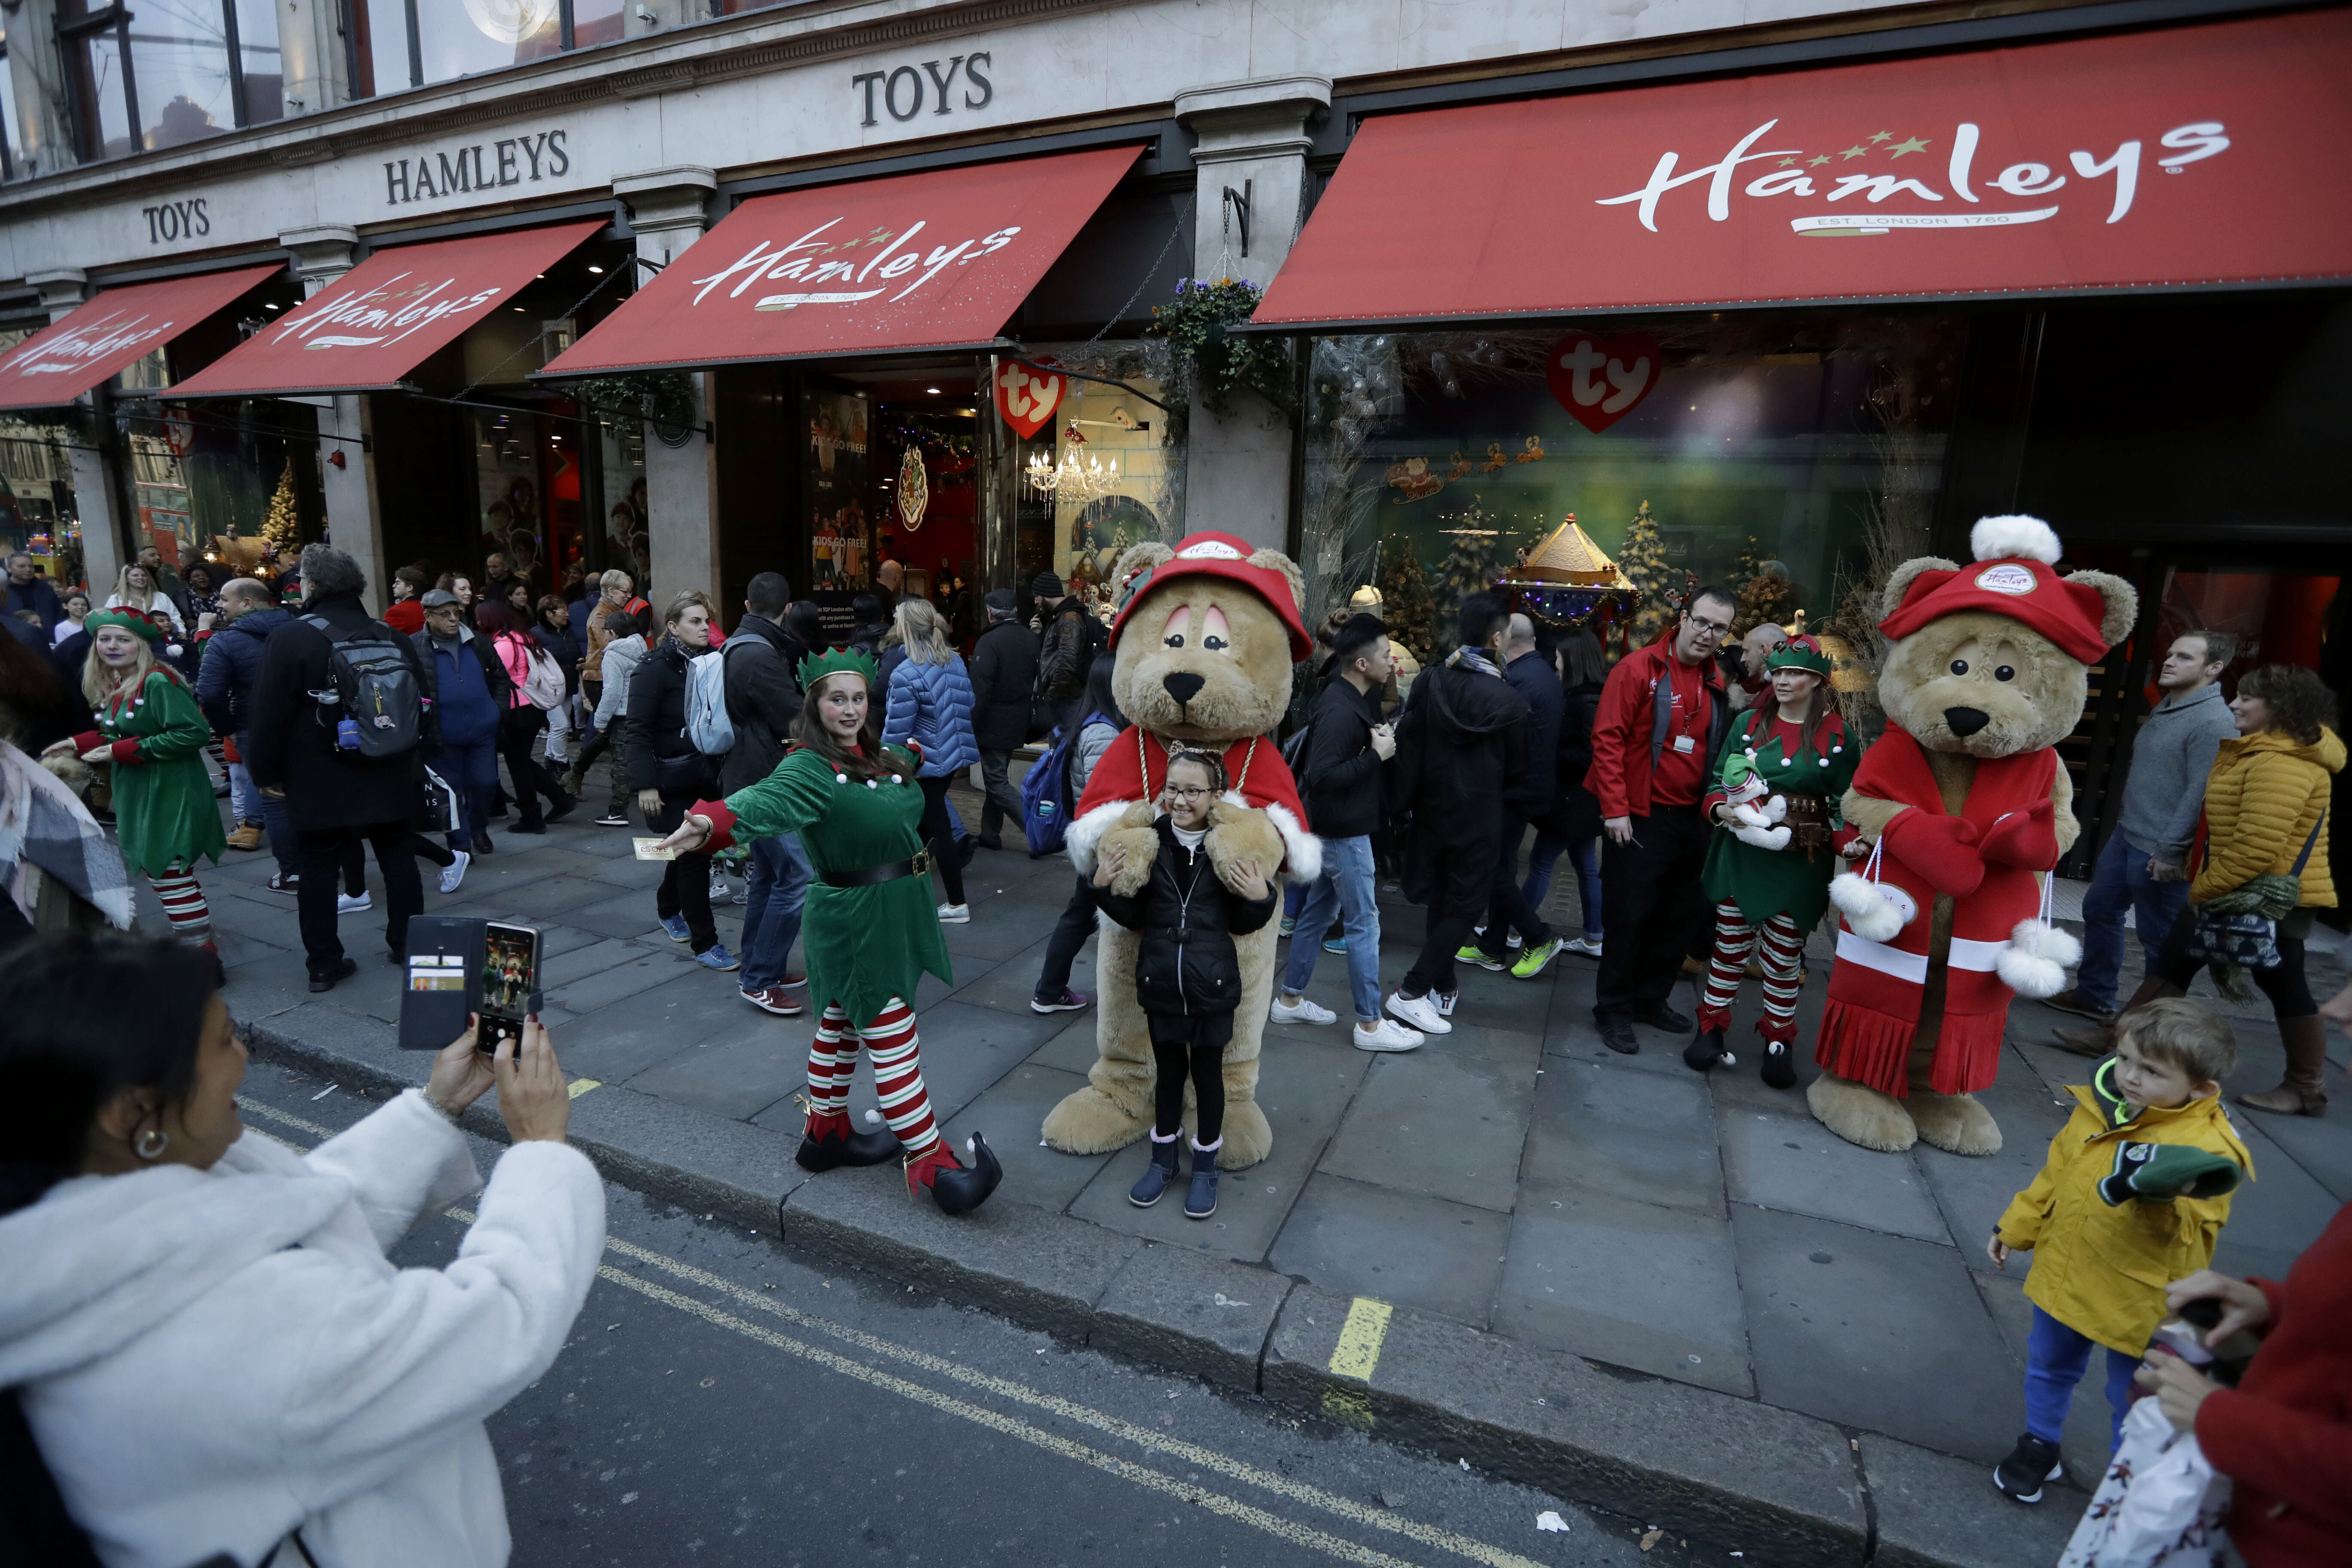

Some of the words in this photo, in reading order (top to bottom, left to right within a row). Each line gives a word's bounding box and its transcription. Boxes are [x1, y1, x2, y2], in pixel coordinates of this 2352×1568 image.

[852, 51, 992, 127] TOYS
[383, 129, 569, 205] HAMLEYS
[1595, 119, 2230, 232] Hamleys
[143, 198, 210, 244] TOYS
[692, 217, 1021, 306] Hamleys
[272, 271, 502, 348] Hamleys
[999, 363, 1060, 423] ty
[1560, 340, 1651, 414] ty
[833, 440, 845, 450] GO
[846, 441, 867, 454] FREE!
[813, 536, 832, 546] KIDS
[833, 538, 846, 547] GO
[847, 538, 867, 548] FREE!
[1985, 571, 2027, 587] Hamleys
